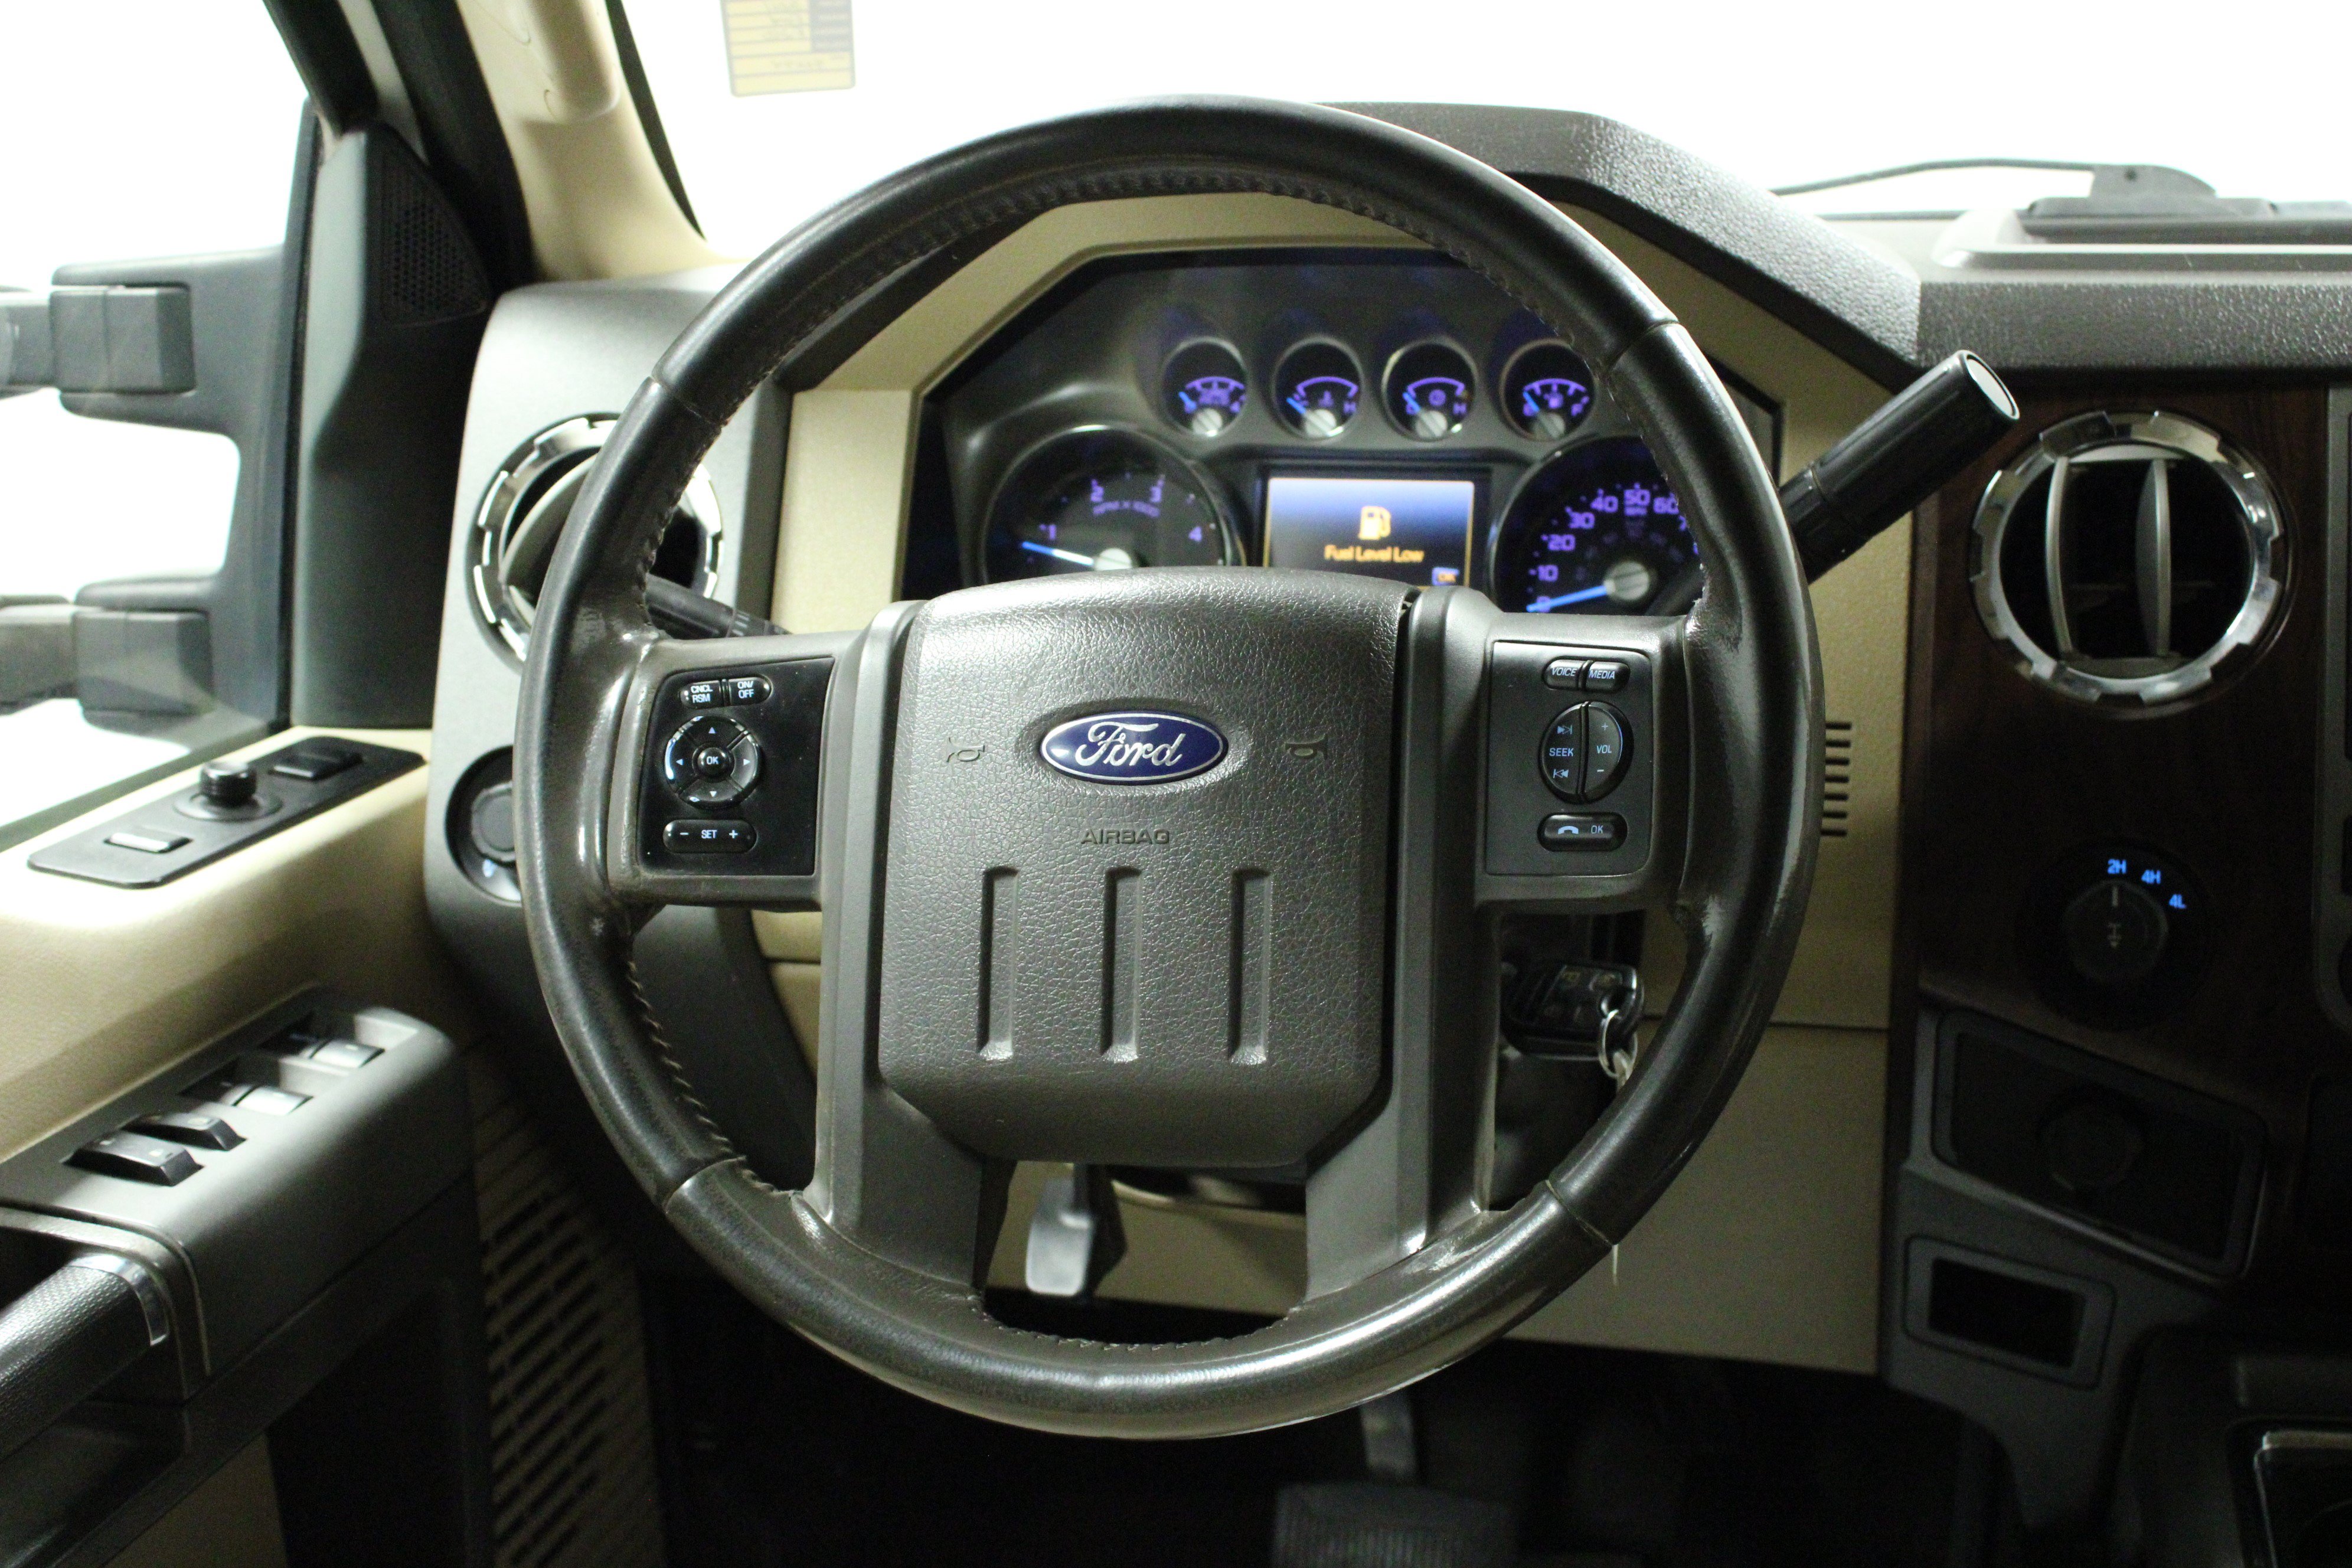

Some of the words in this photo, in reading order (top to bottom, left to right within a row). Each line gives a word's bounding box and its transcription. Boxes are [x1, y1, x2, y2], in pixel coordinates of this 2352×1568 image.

[1091, 486, 1104, 502] 2
[1151, 486, 1162, 502] 3
[1623, 489, 1651, 506] 50
[1590, 495, 1619, 513] 40
[1653, 497, 1679, 514] 60
[1569, 512, 1595, 529] 30
[1188, 526, 1202, 543] 4
[1547, 534, 1576, 551] 20
[1324, 544, 1354, 561] Fuel
[1355, 545, 1393, 562] Level
[1393, 546, 1425, 563] Low
[1537, 564, 1559, 582] 10
[1551, 667, 1577, 677] VOICE
[1588, 669, 1616, 680] MEDIA
[690, 685, 713, 694] CNCL
[738, 688, 754, 699] OFF
[692, 693, 711, 703] RSM
[1074, 721, 1186, 767] Ford
[1549, 747, 1574, 757] SEEK
[1596, 745, 1612, 754] VOL
[705, 755, 720, 765] OK
[701, 829, 718, 839] SET
[1080, 828, 1171, 845] AIRBAG
[1590, 825, 1603, 834] OK
[2106, 858, 2127, 875] 2H
[2141, 870, 2161, 884] 4H
[2168, 893, 2187, 910] 4L
